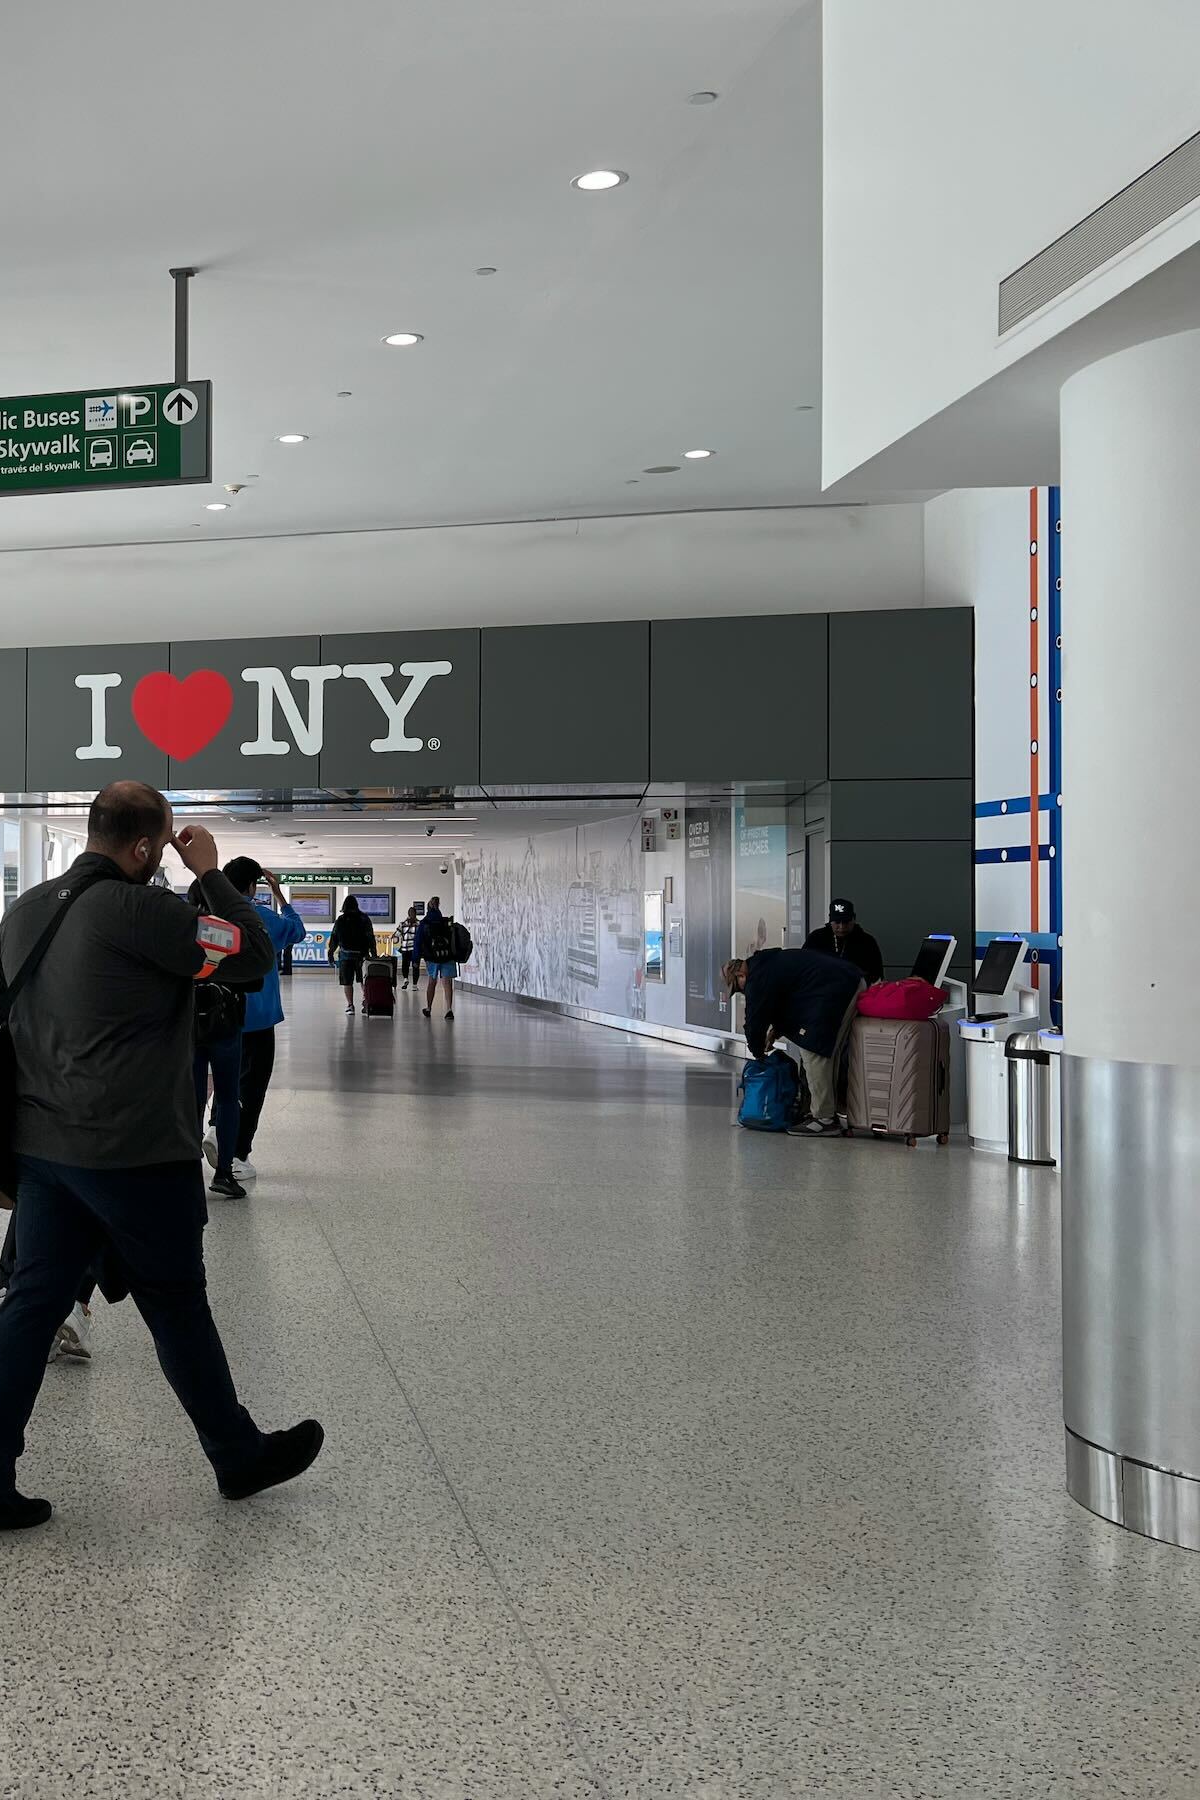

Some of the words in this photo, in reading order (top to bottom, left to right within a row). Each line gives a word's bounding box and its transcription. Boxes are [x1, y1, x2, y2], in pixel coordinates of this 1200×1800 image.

[23, 409, 80, 429] Buses
[0, 464, 27, 475] través
[29, 463, 43, 473] del
[44, 460, 81, 473] skywalk
[74, 672, 122, 760] I
[688, 822, 702, 836] OVER
